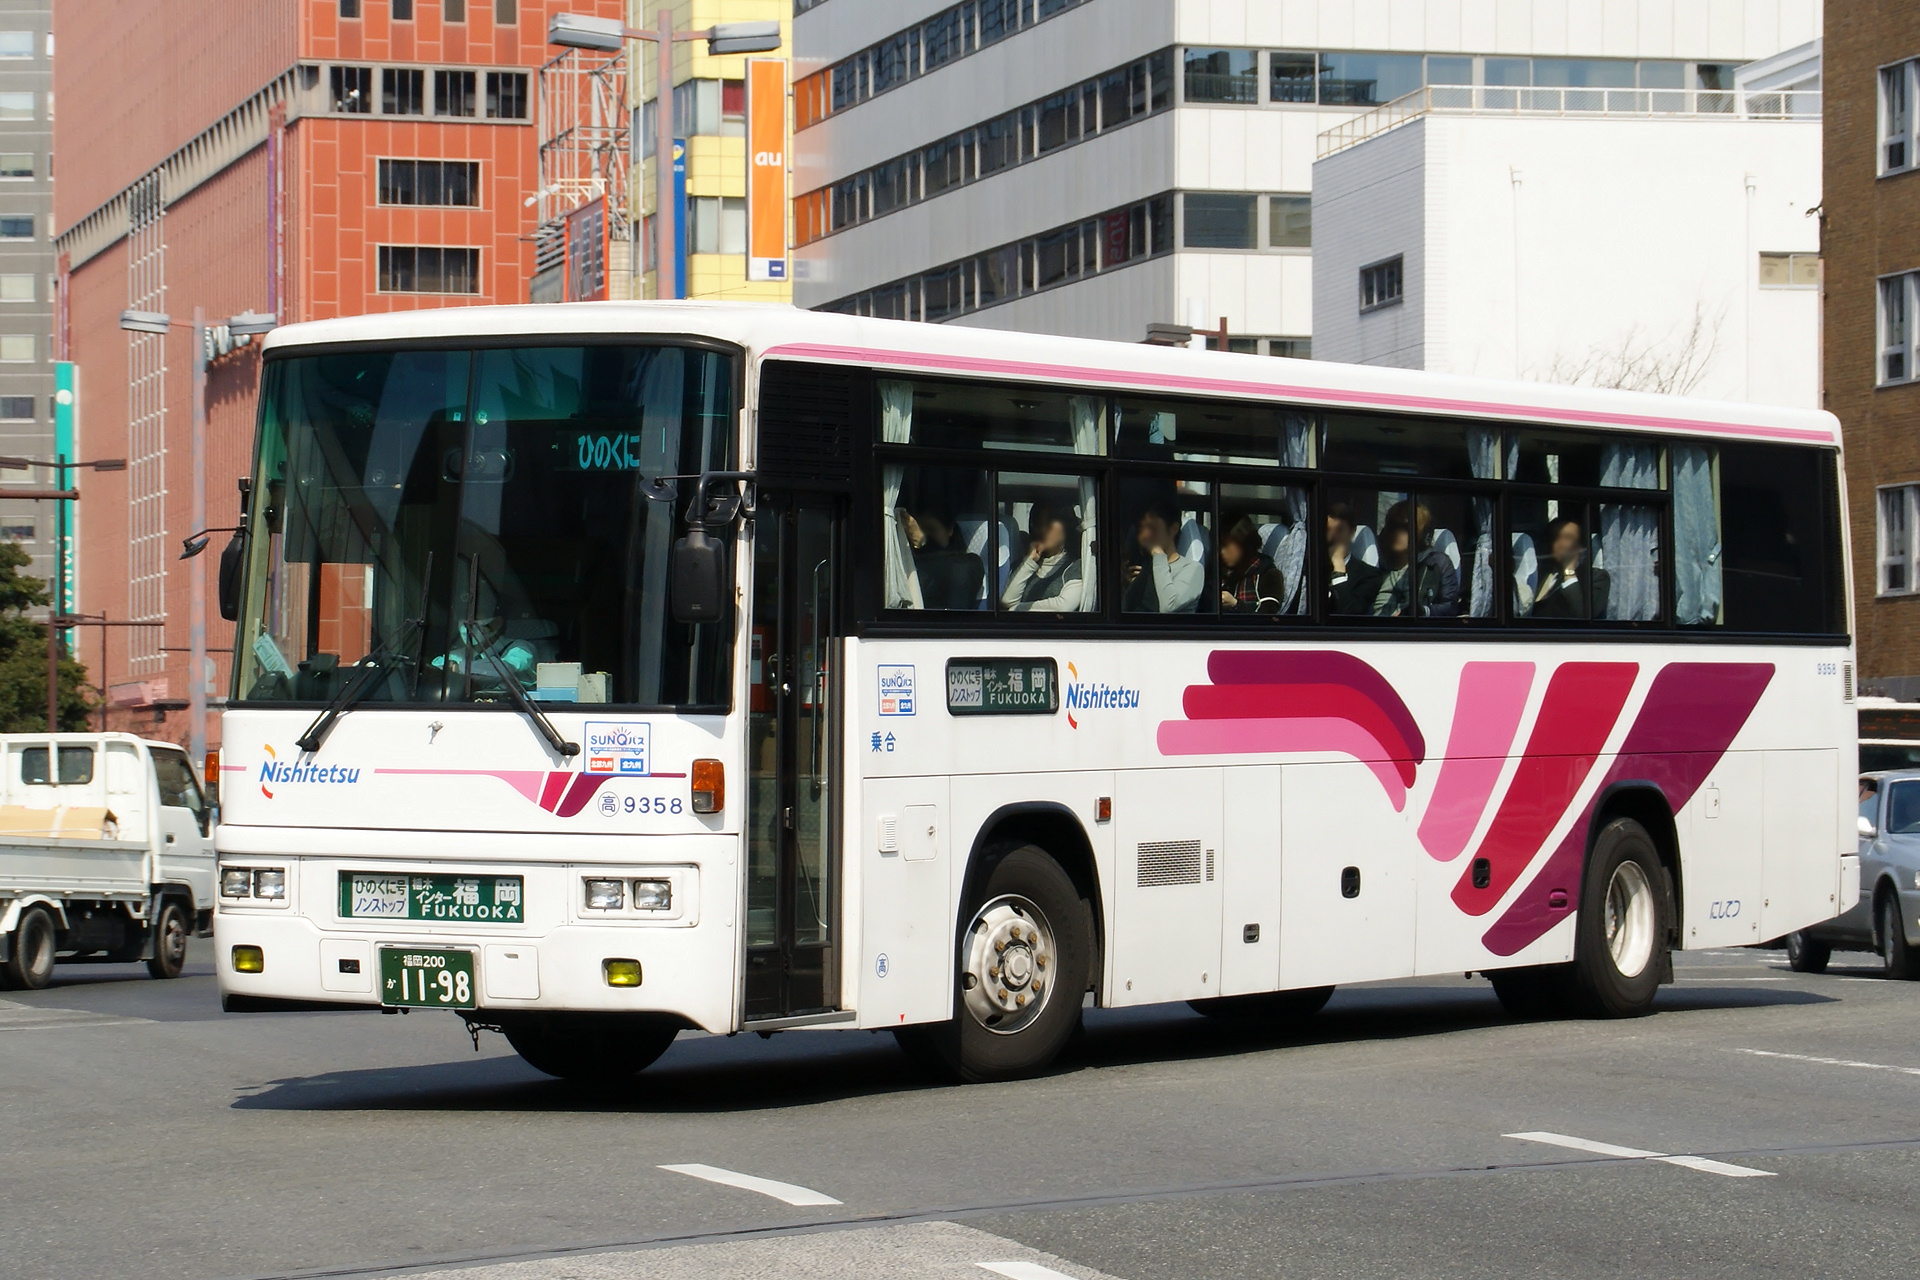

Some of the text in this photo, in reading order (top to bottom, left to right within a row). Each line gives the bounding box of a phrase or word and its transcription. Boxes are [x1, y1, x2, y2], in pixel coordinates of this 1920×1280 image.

[755, 151, 782, 166] au
[577, 432, 640, 470] ひのくに
[1817, 663, 1836, 675] 9358
[950, 671, 981, 685] ひのくに号
[1008, 668, 1046, 692] 福岡
[950, 687, 981, 703] ノンストップ
[990, 693, 1045, 705] FUKUOKA
[1066, 683, 1140, 709] Nishitetsu
[871, 731, 896, 752] 乗合
[259, 760, 361, 783] Nishitetsu
[624, 796, 683, 814] 9358
[355, 879, 407, 896] ひのくに号
[452, 878, 520, 906] 福岡
[355, 898, 407, 913] ノンストップ
[416, 891, 452, 904] インター
[421, 904, 518, 918] FUKUOKA
[386, 978, 397, 989] か
[402, 968, 470, 1003] 11-98
